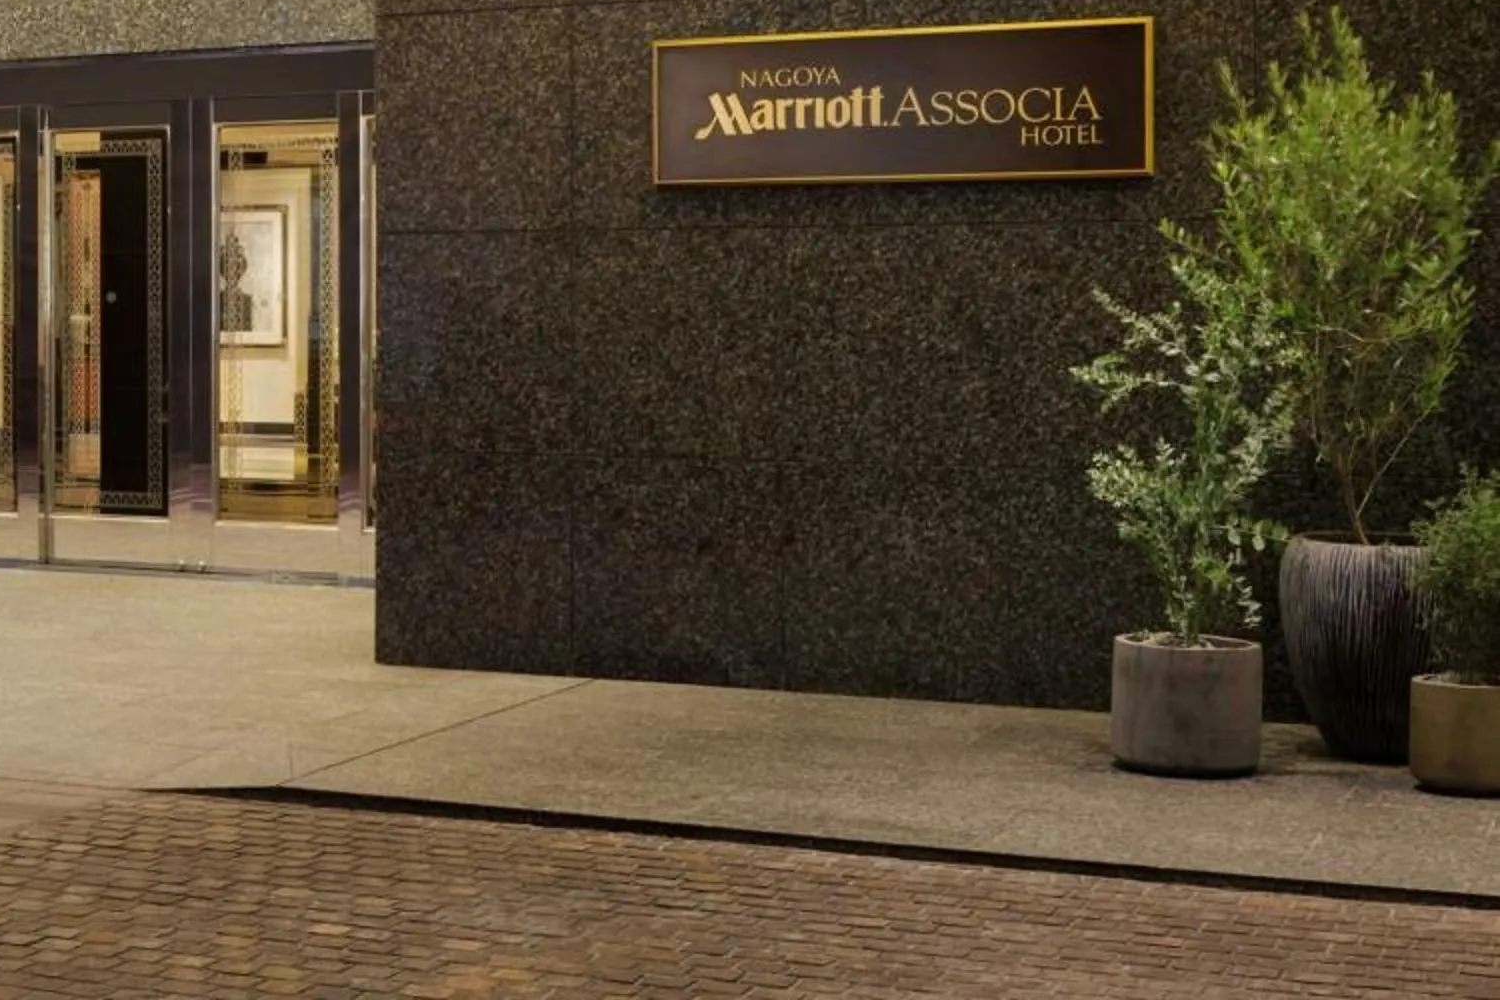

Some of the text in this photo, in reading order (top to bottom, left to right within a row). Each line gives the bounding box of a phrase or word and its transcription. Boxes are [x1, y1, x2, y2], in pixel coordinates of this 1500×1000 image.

[740, 66, 842, 88] NAGOYA
[891, 86, 1103, 127] ASSOCIA
[1020, 125, 1104, 146] HOTEL
